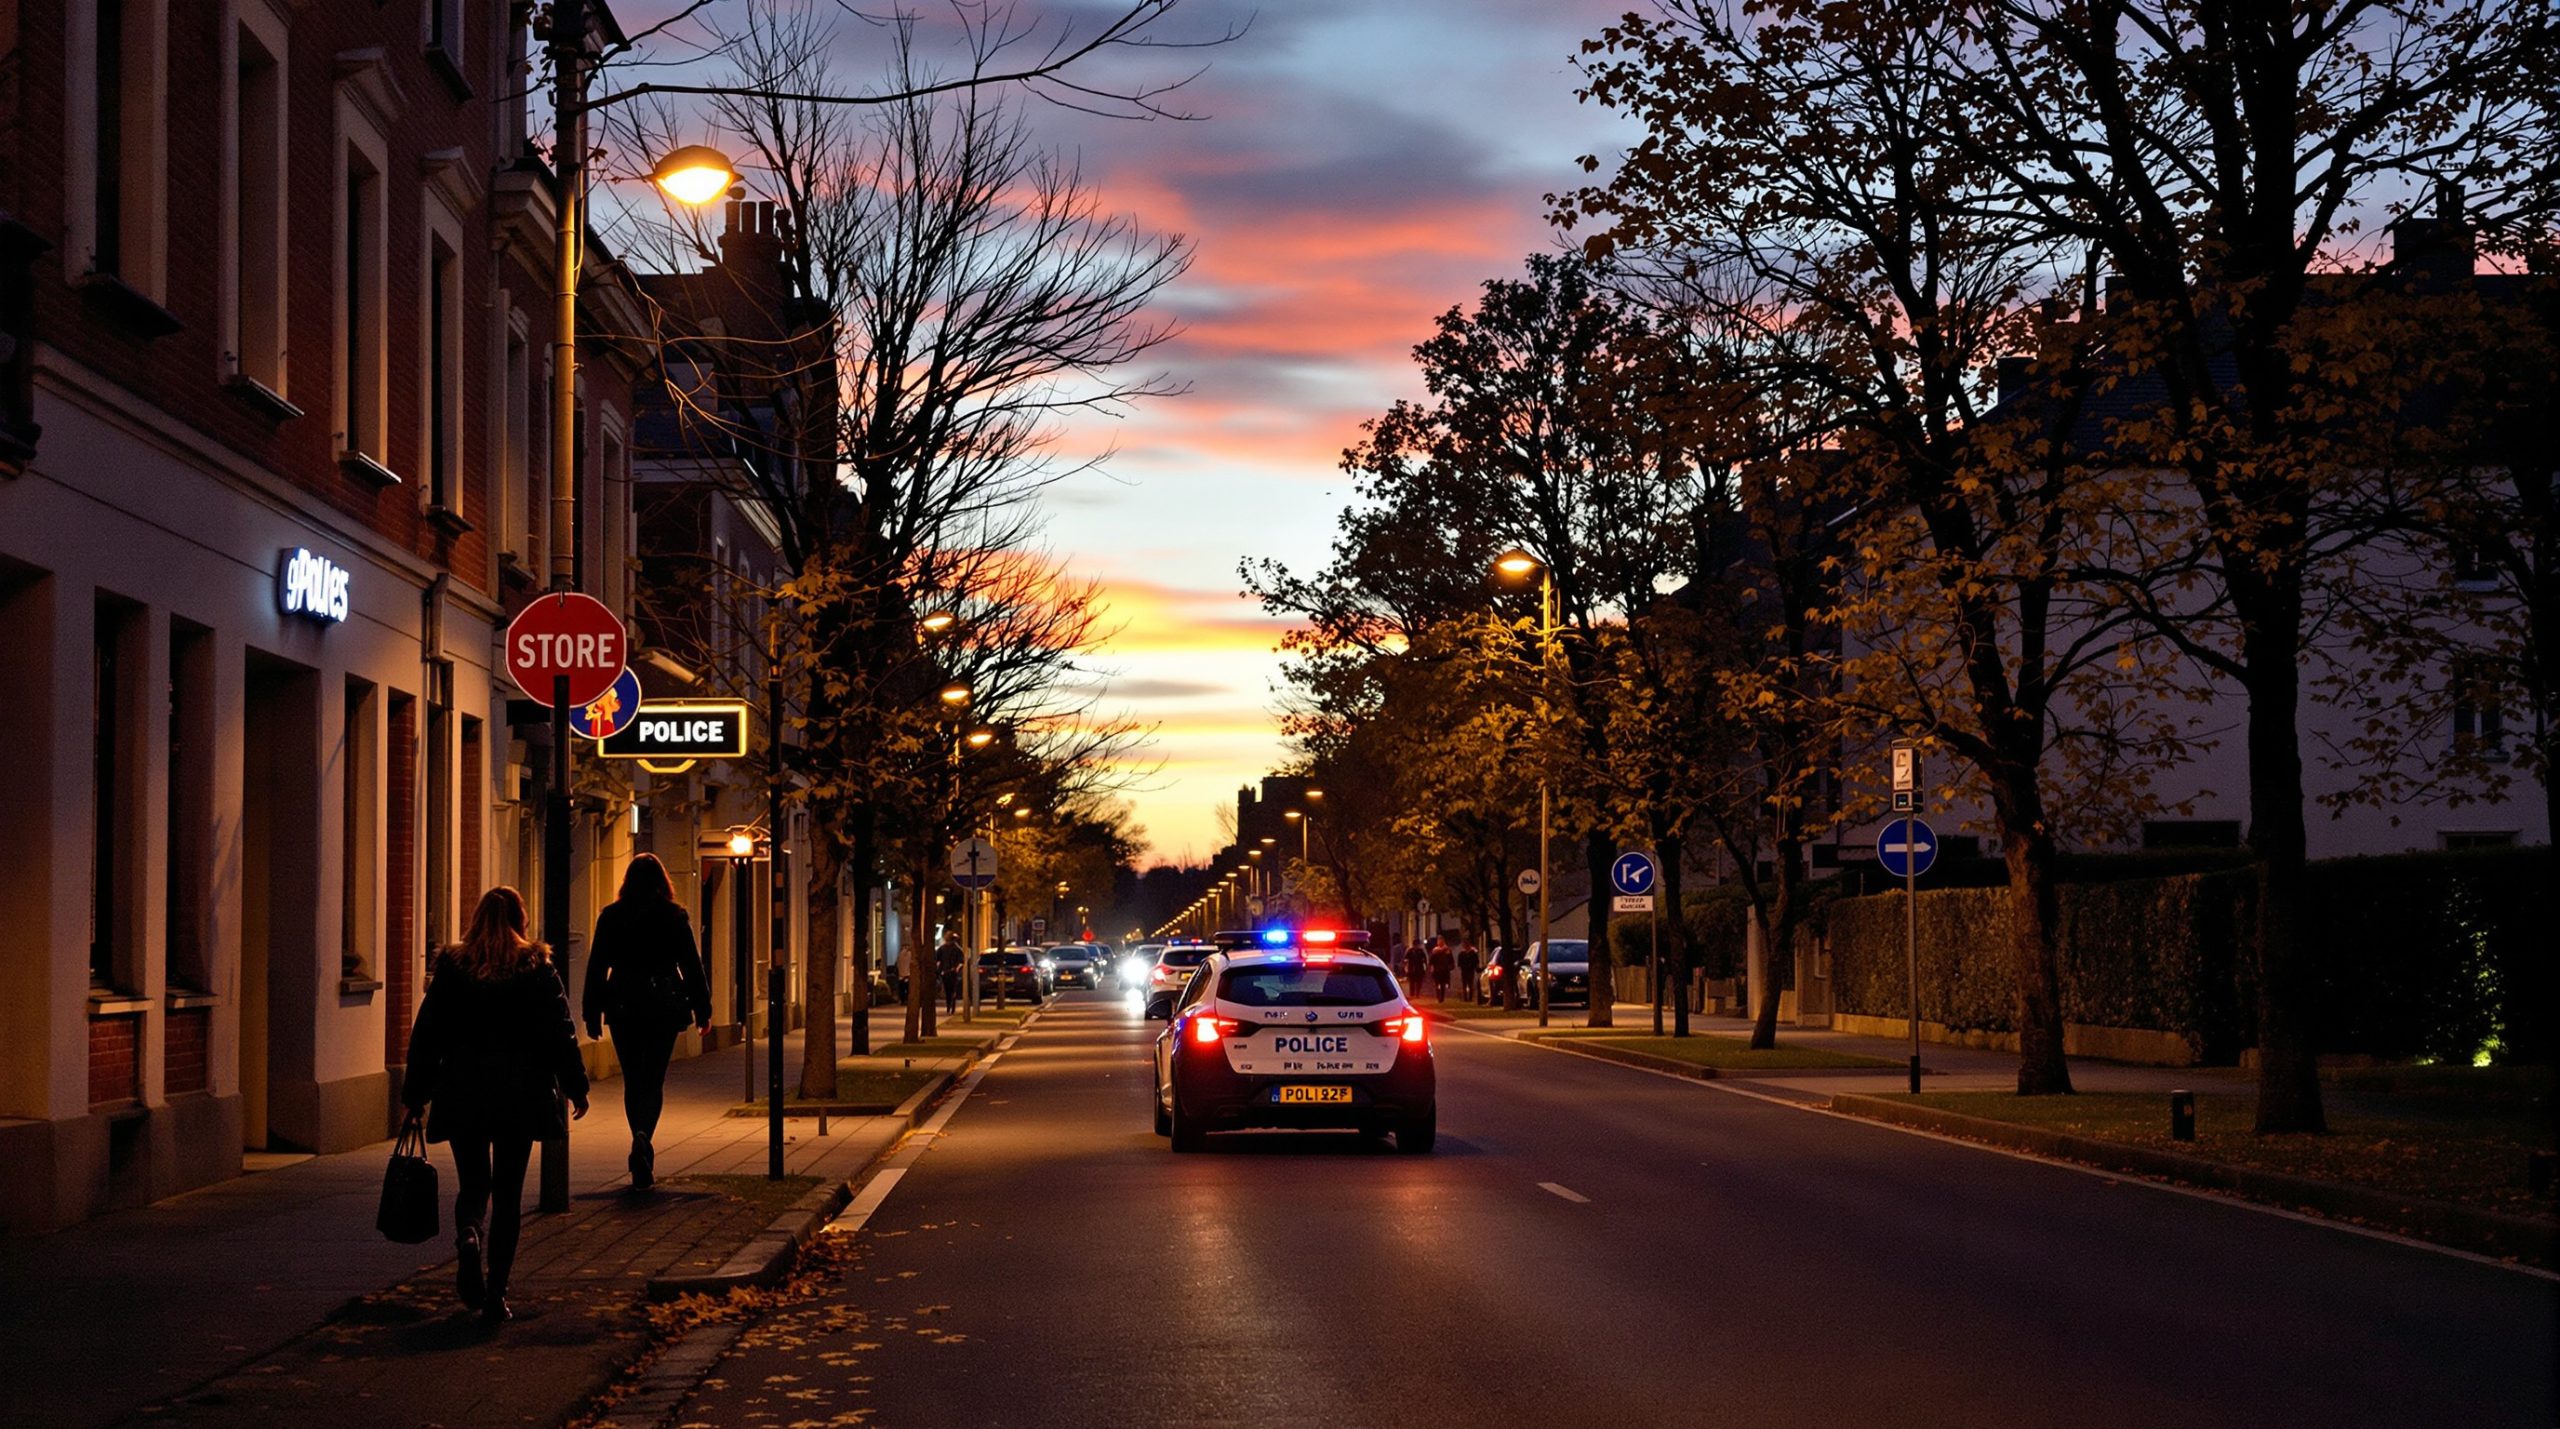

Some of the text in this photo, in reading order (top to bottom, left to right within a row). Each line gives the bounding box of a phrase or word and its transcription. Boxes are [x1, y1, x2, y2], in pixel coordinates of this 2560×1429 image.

[516, 633, 616, 669] STORE
[639, 721, 724, 743] POLICE
[1275, 1037, 1348, 1053] POLICE
